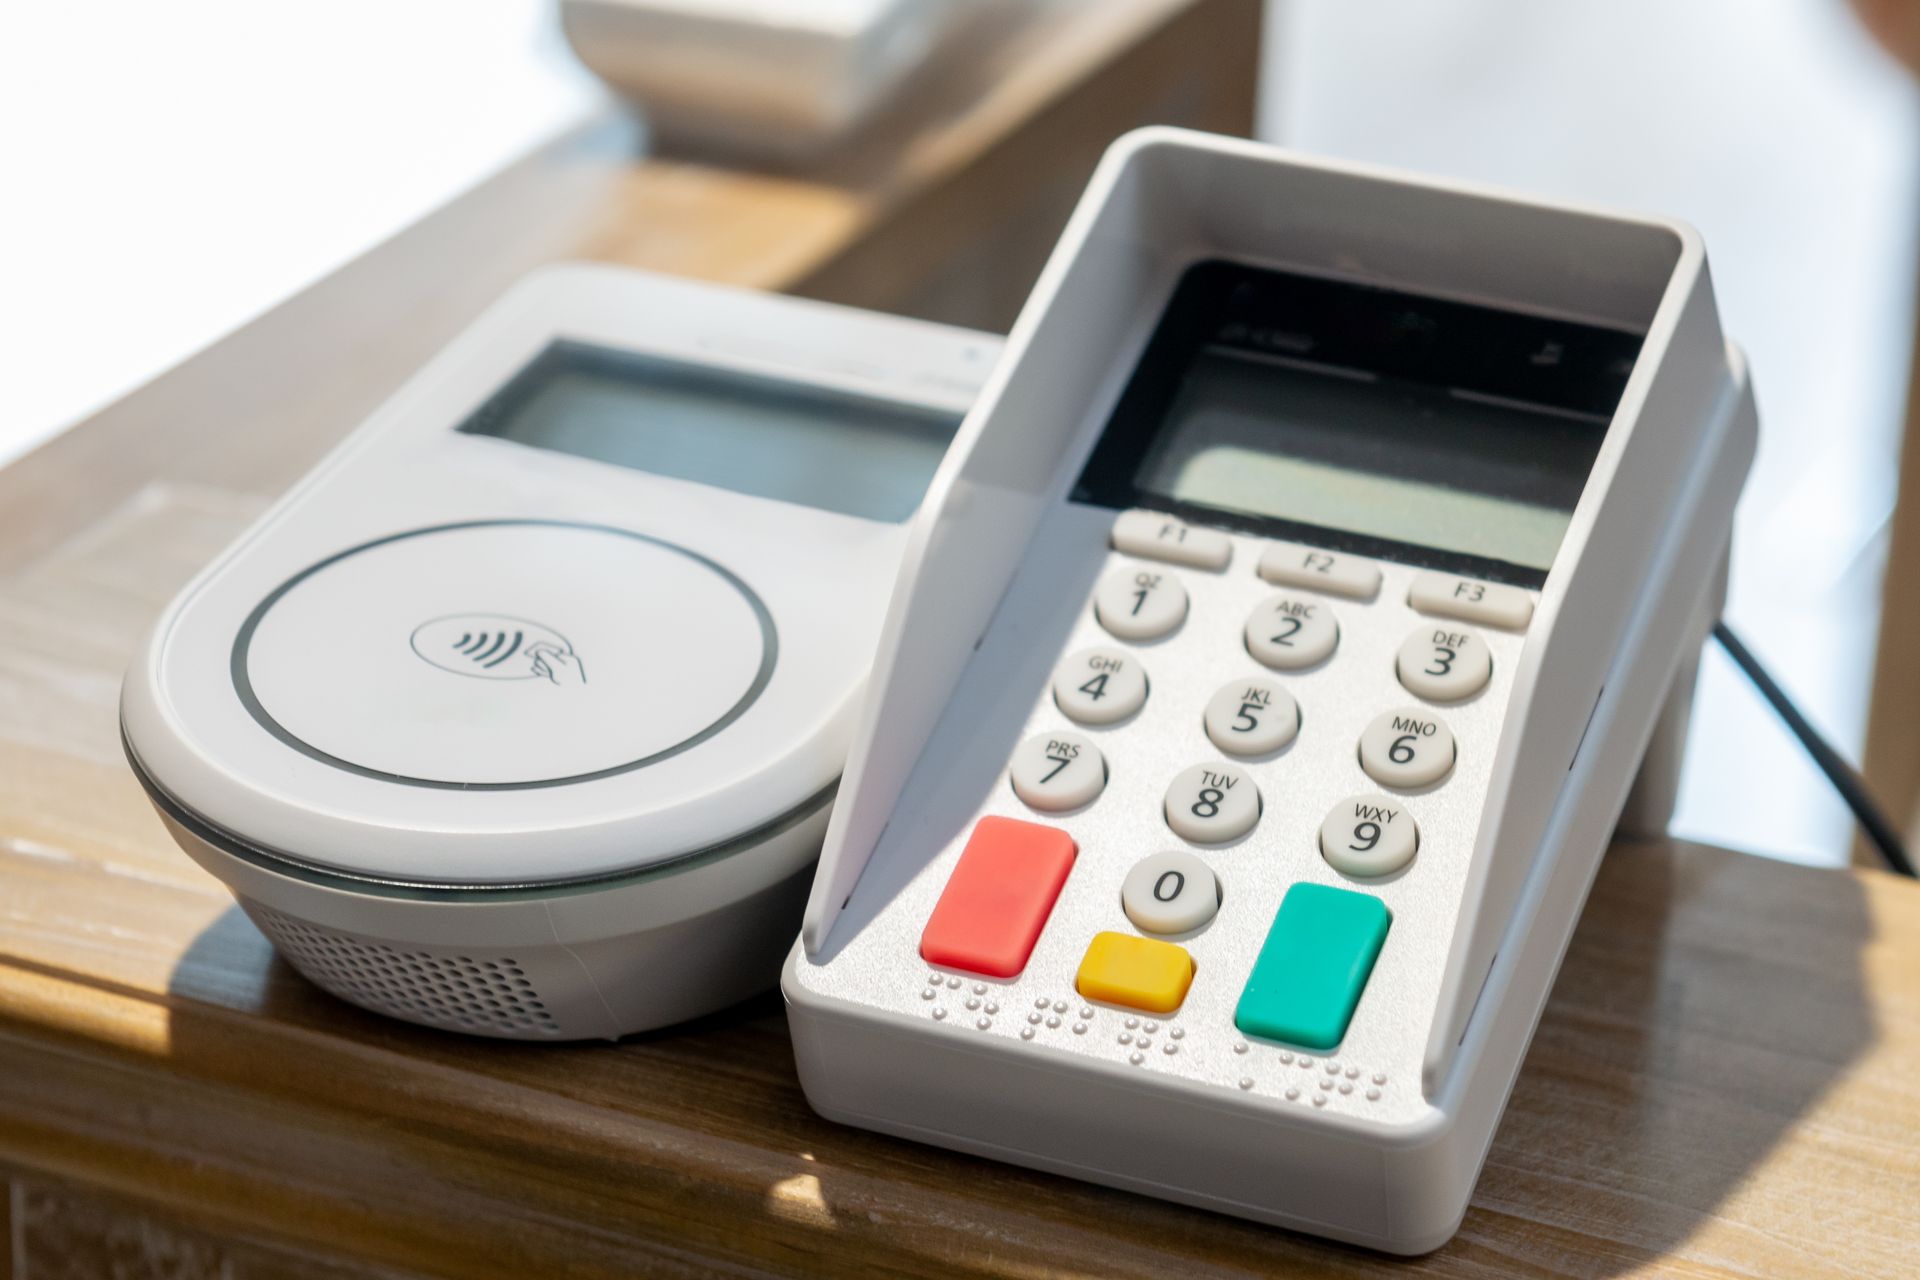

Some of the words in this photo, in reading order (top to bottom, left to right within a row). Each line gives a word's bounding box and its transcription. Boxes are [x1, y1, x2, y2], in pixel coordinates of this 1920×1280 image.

[1158, 522, 1188, 544] F1
[1303, 552, 1335, 574] F2
[1135, 571, 1163, 589] QZ
[1131, 589, 1149, 617] 1
[1454, 582, 1487, 602] F3
[1276, 600, 1317, 619] ABC
[1270, 617, 1302, 647] 2
[1433, 629, 1468, 648] DEF
[1089, 656, 1123, 674] GHI
[1424, 647, 1457, 677] 3
[1078, 673, 1109, 702] 4
[1240, 687, 1271, 706] JKL
[1231, 703, 1264, 733] 5
[1391, 715, 1437, 738] MNO
[1046, 739, 1081, 759] PRS
[1387, 734, 1418, 765] 6
[1039, 755, 1071, 785] 7
[1201, 770, 1239, 791] TUV
[1191, 787, 1226, 819] 8
[1354, 803, 1398, 825] WXY
[1348, 821, 1382, 852] 9
[1152, 869, 1185, 903] 0
